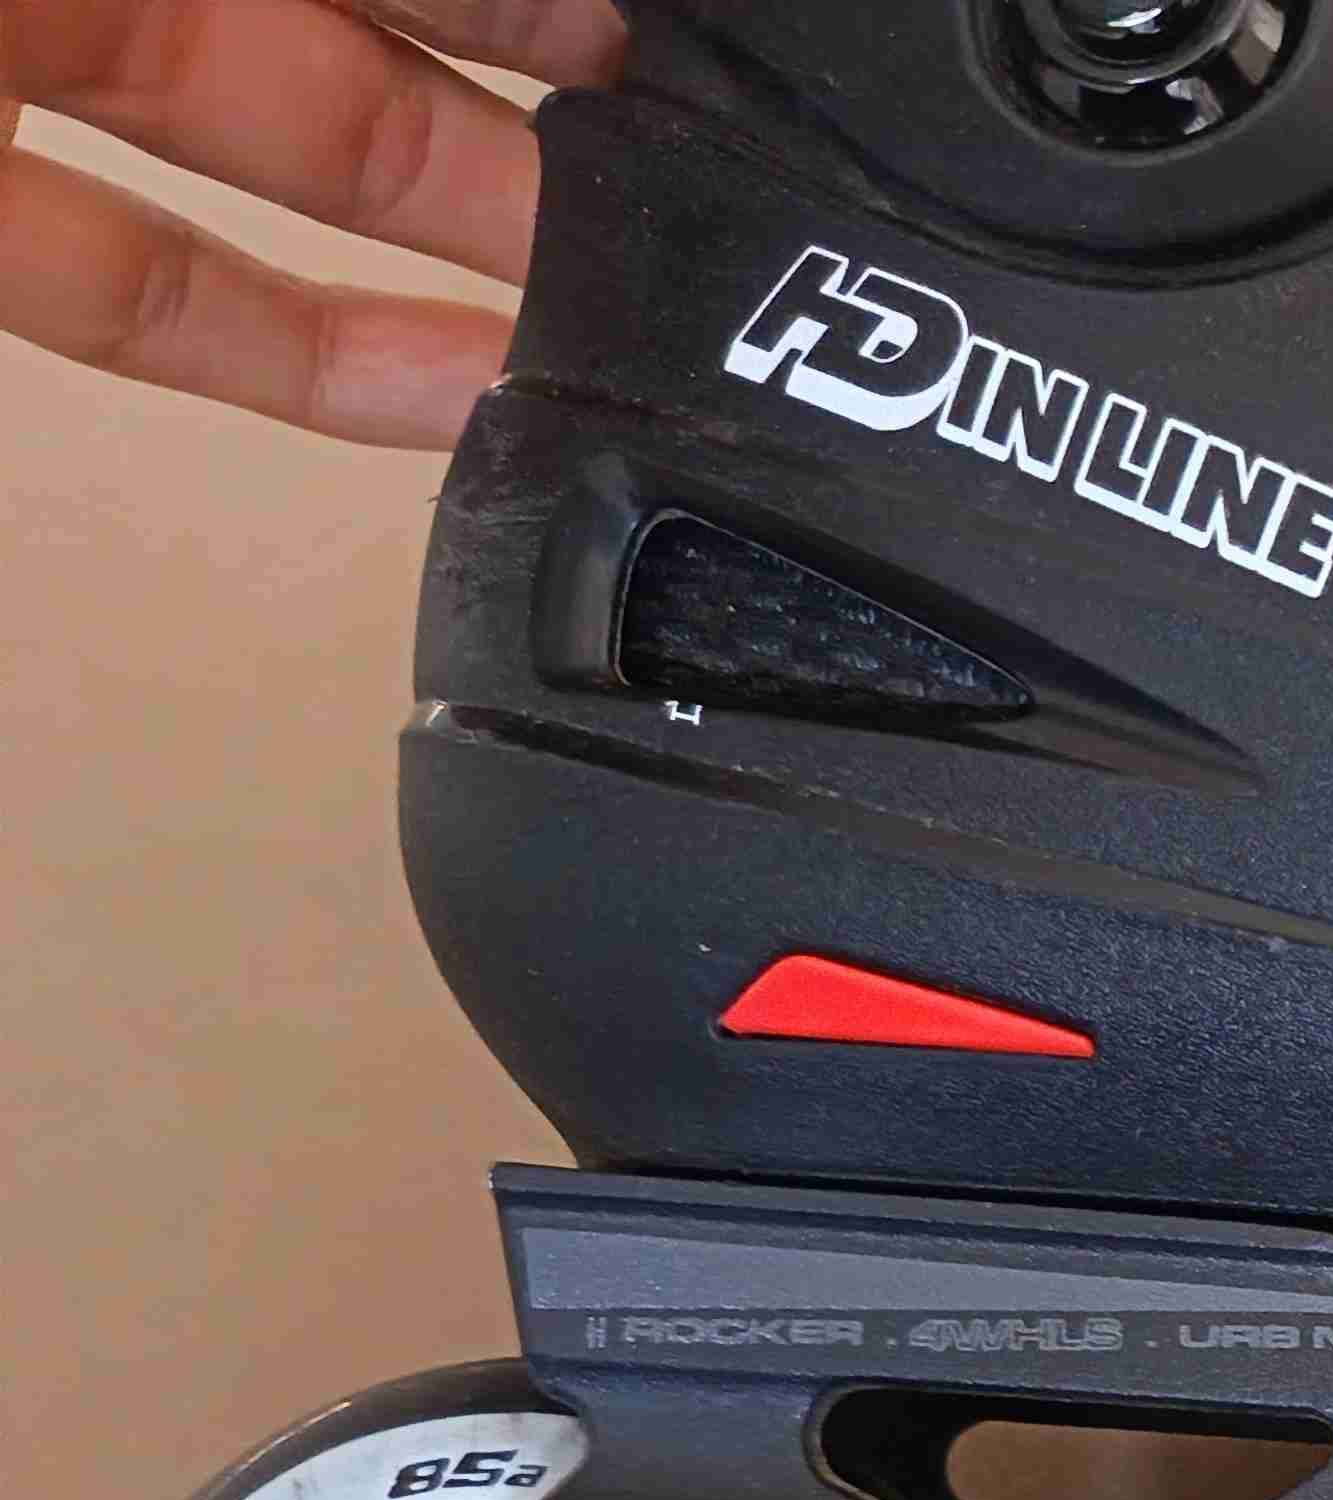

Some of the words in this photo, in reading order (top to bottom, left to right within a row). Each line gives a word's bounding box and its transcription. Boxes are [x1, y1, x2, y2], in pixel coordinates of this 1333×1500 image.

[623, 1315, 864, 1347] ROCKER
[1178, 1323, 1301, 1350] URB
[387, 1450, 549, 1500] 85a
